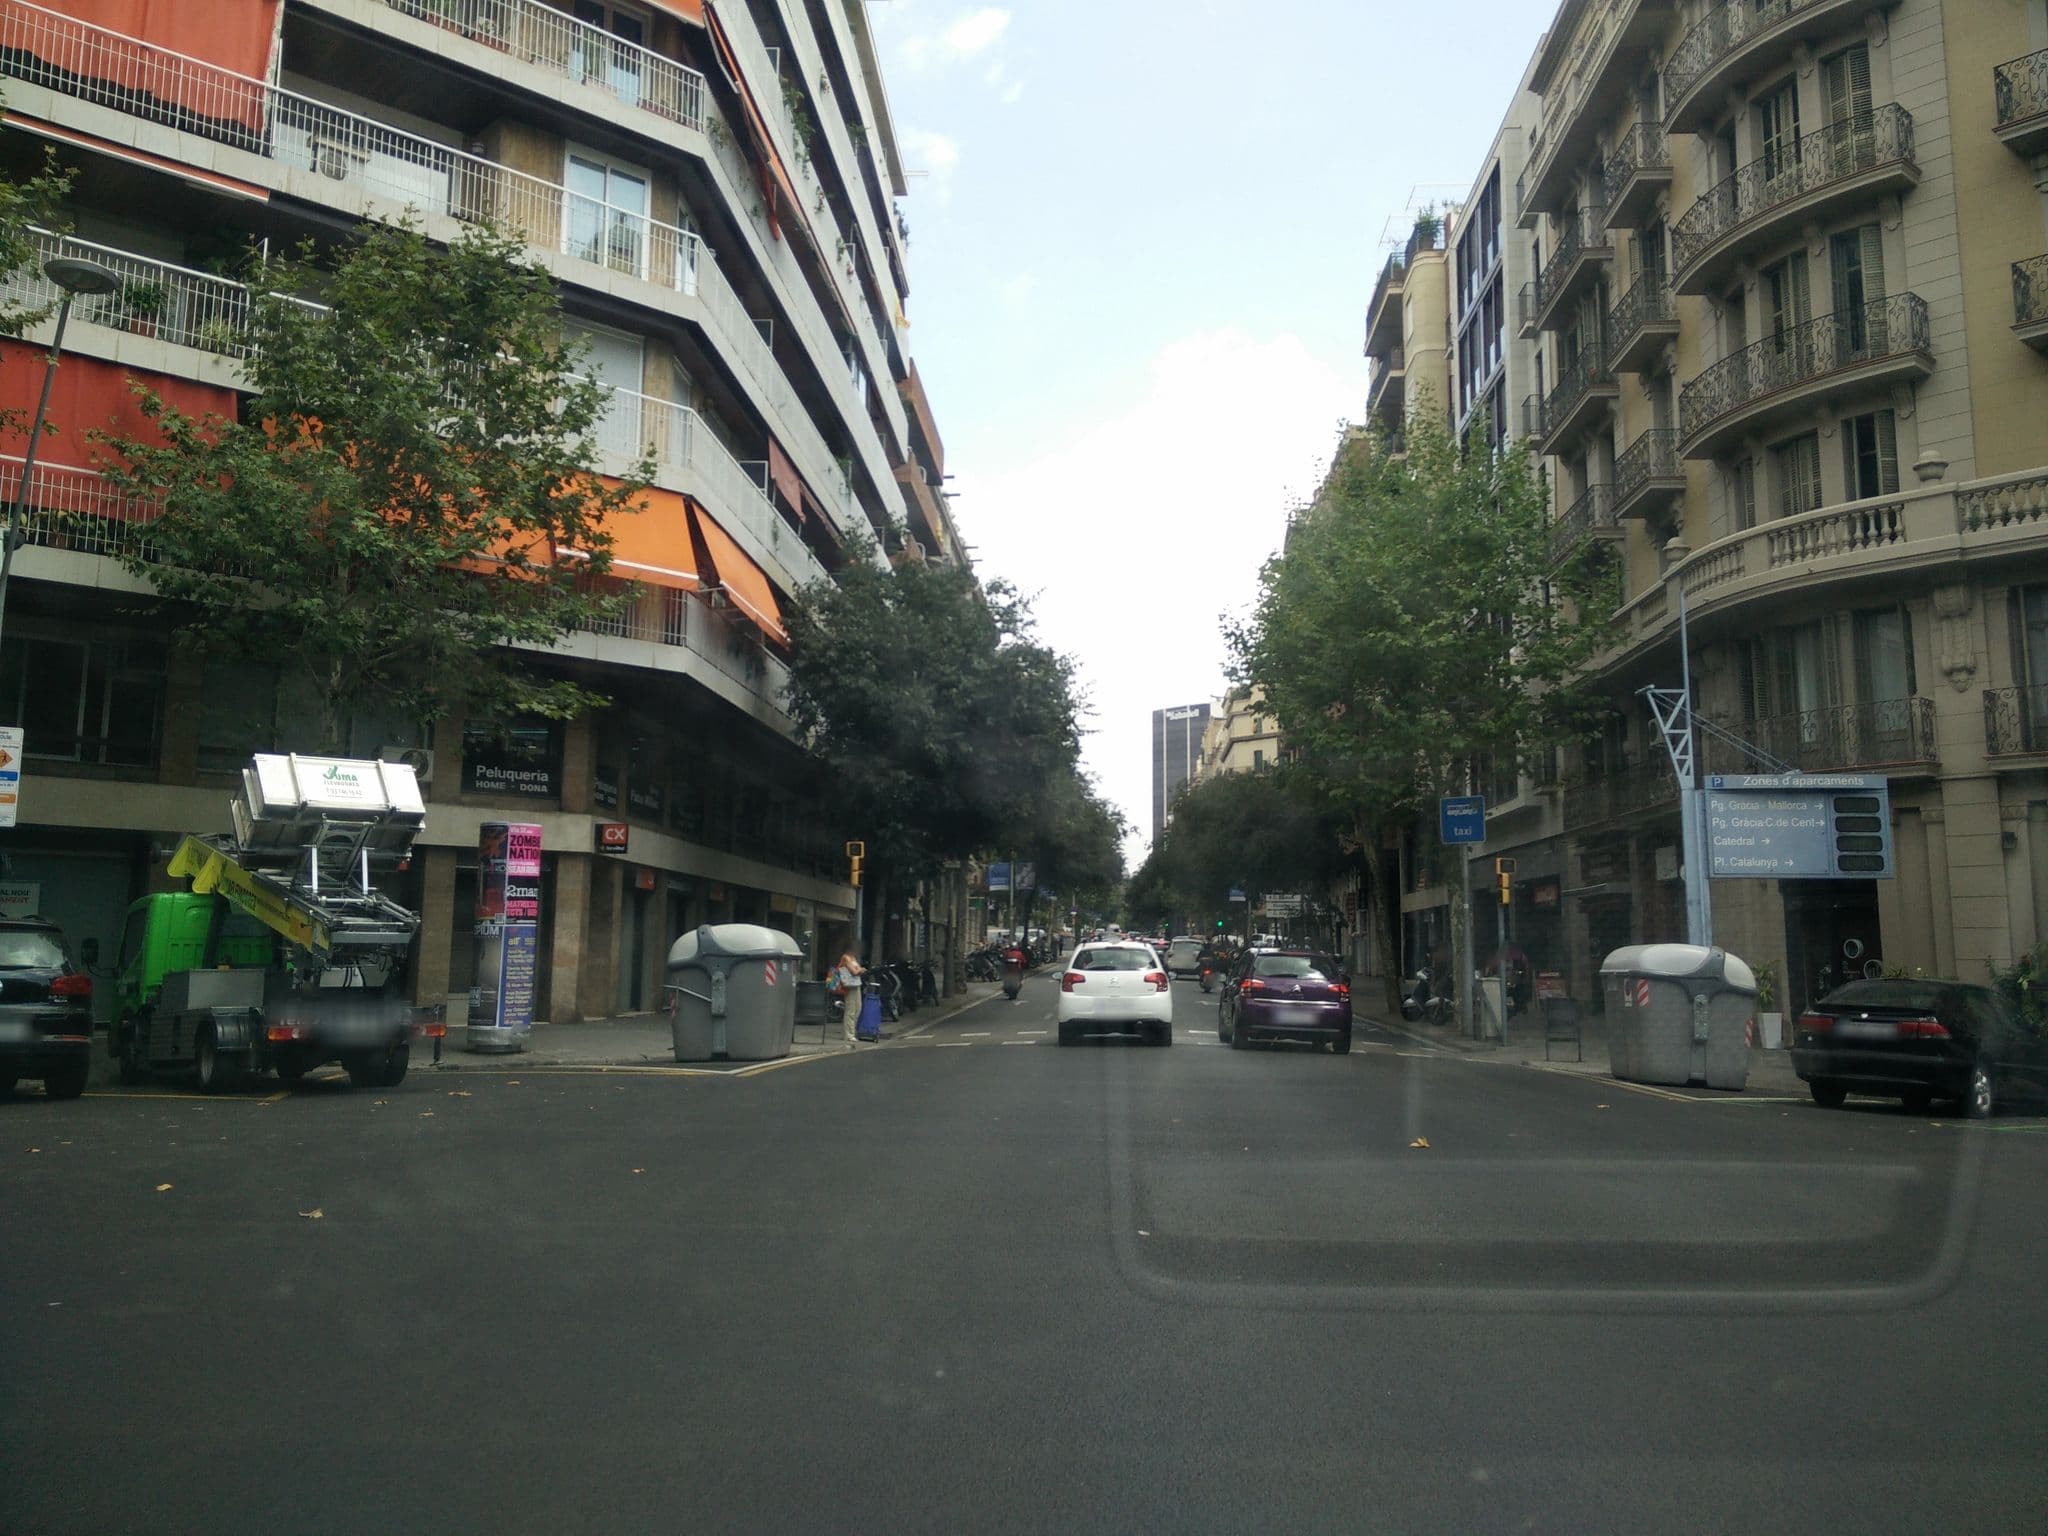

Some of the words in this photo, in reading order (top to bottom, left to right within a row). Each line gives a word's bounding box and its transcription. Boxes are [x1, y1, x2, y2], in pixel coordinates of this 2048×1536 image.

[476, 765, 549, 782] Peluqueria
[475, 780, 506, 790] HOME
[519, 783, 549, 793] DONA
[1743, 776, 1779, 786] Zones
[1768, 800, 1808, 810] Mallorca
[1712, 817, 1728, 829] Pg.
[605, 828, 625, 840] CX
[1454, 826, 1472, 836] taxi
[1713, 836, 1755, 846] Catedral
[1730, 857, 1778, 868] Catalunya
